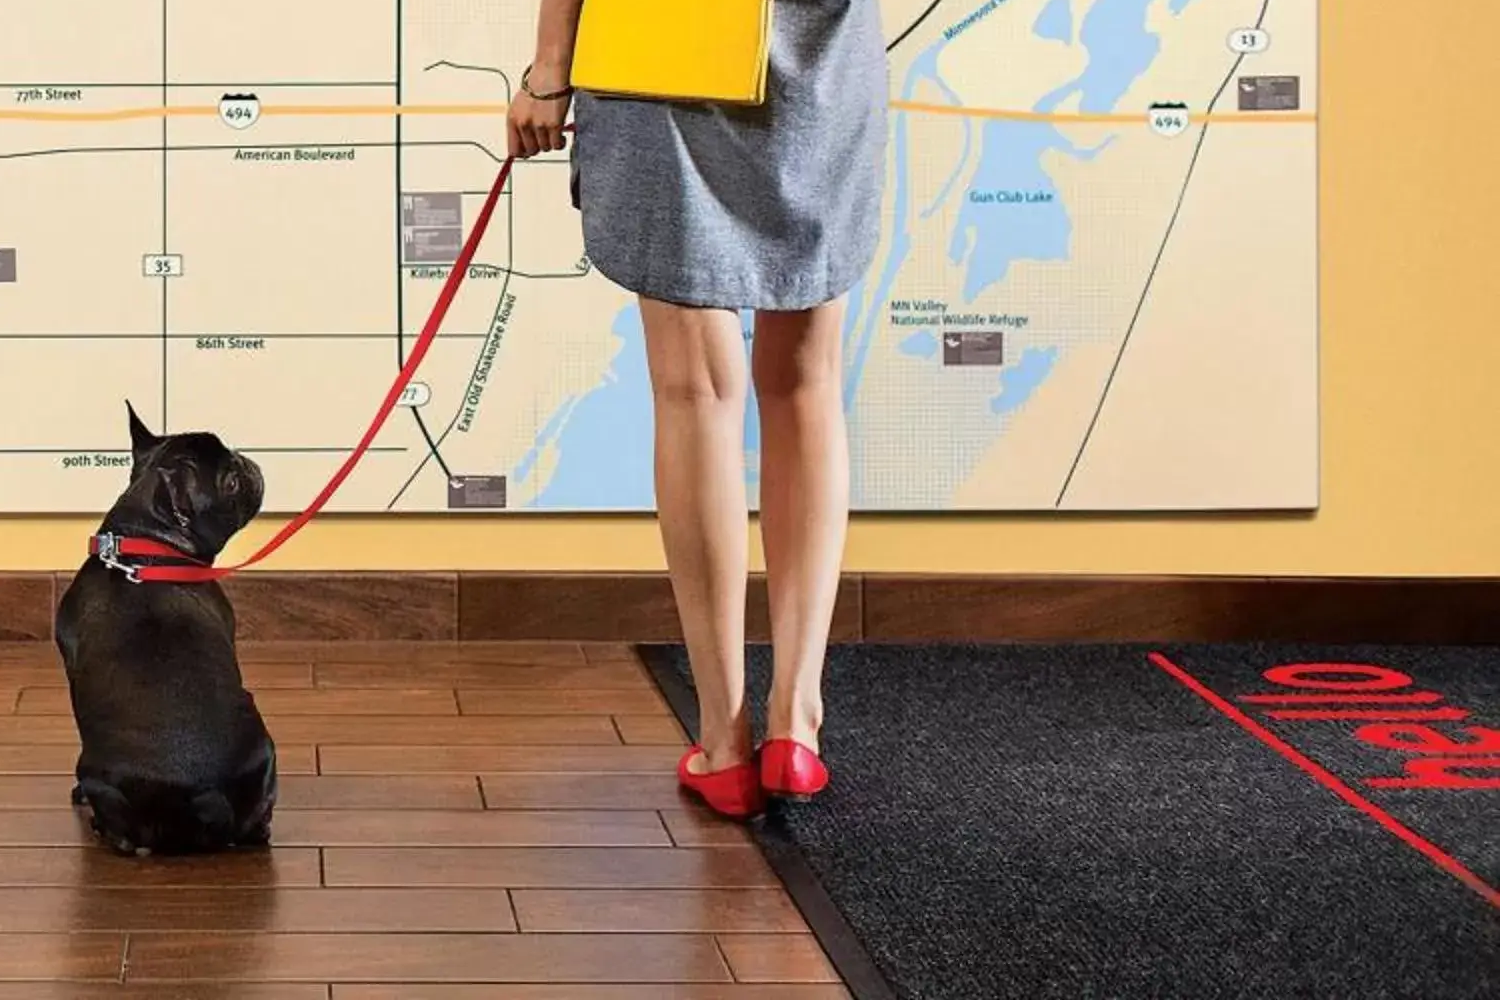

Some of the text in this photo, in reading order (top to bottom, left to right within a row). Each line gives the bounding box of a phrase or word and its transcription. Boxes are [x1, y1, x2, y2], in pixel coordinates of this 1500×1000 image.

[16, 89, 81, 102] 77th Street
[225, 107, 252, 119] 494
[1155, 116, 1181, 129] 494
[234, 149, 355, 161] American Boulevard
[970, 190, 1053, 203] Gun Club Lake
[155, 261, 171, 273] 35
[469, 267, 500, 279] Drive
[891, 301, 947, 315] MN Valley
[891, 314, 1028, 328] National Wildlife Refuge
[197, 338, 264, 349] 86th Street
[457, 292, 517, 433] East Old Shakopee Road
[63, 456, 130, 468] 90th Street
